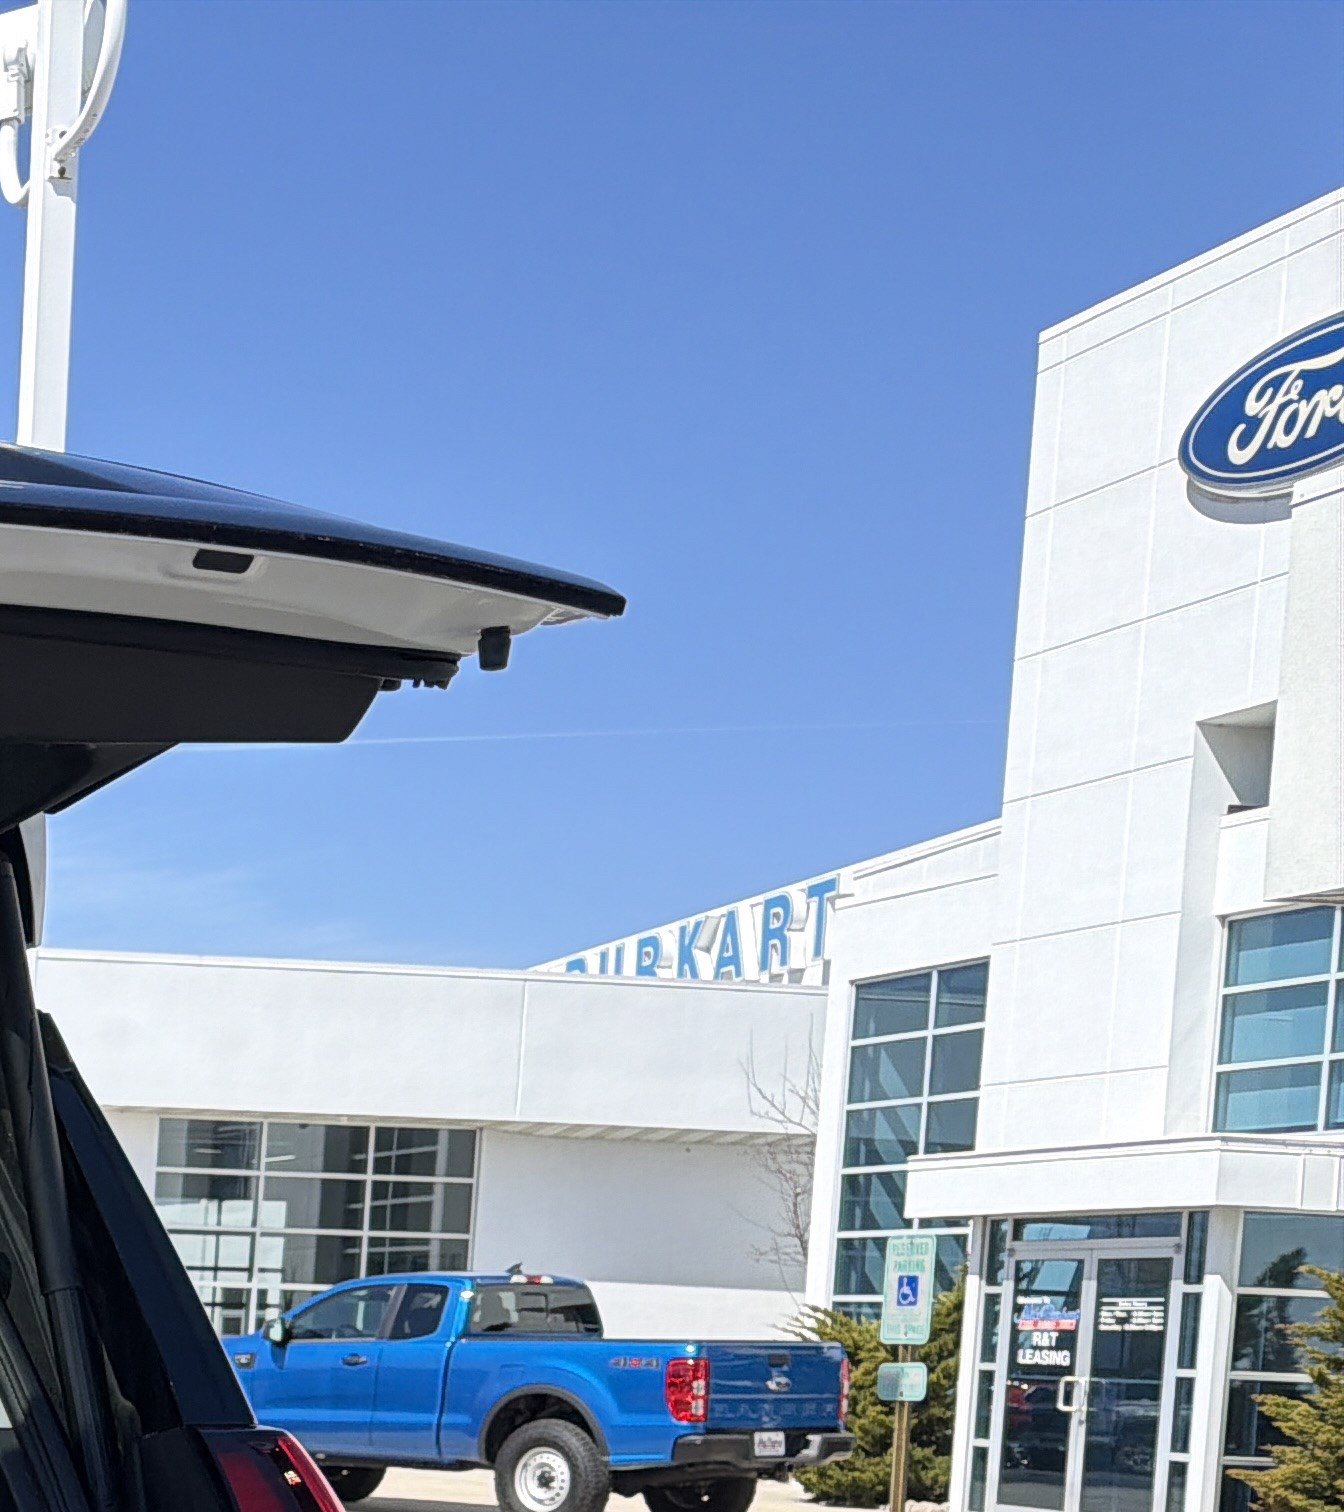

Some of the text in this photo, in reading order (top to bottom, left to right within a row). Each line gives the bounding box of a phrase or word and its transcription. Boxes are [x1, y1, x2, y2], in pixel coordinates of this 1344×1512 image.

[1227, 347, 1344, 466] For
[565, 877, 838, 980] RKART
[1016, 1348, 1071, 1367] LEASING
[1032, 1331, 1059, 1347] R&T
